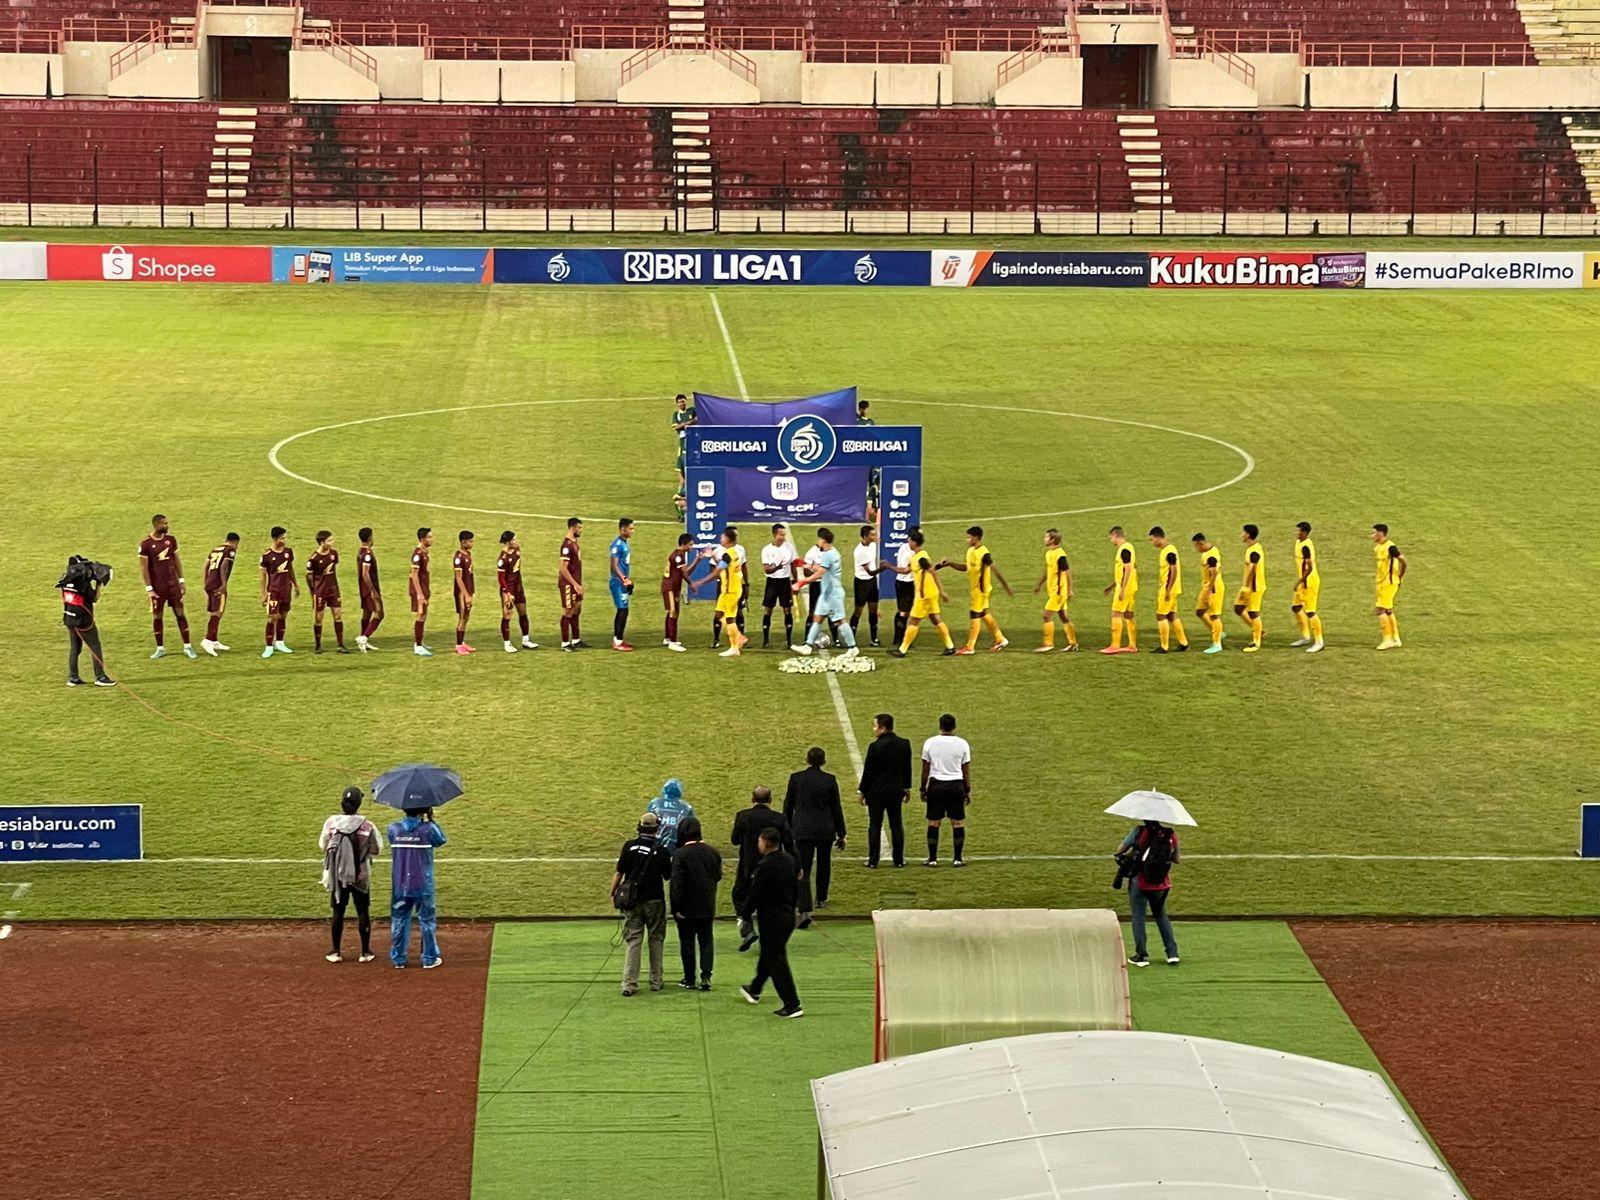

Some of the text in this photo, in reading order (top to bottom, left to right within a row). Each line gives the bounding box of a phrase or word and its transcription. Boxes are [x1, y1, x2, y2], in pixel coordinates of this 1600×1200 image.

[1110, 23, 1121, 43] 7
[343, 252, 424, 265] LIB Super App
[655, 253, 702, 280] BRI
[138, 257, 216, 282] Shopee
[992, 262, 1144, 278] ligaindonesiabaru.com
[1150, 256, 1319, 285] KukuBima
[1321, 264, 1366, 275] KukuBima
[1375, 262, 1574, 280] #SemuaPakeBRImo
[713, 441, 732, 452] BRI
[855, 440, 873, 452] BRI
[776, 481, 794, 490] BRI
[0, 815, 116, 831] esiabaru.com
